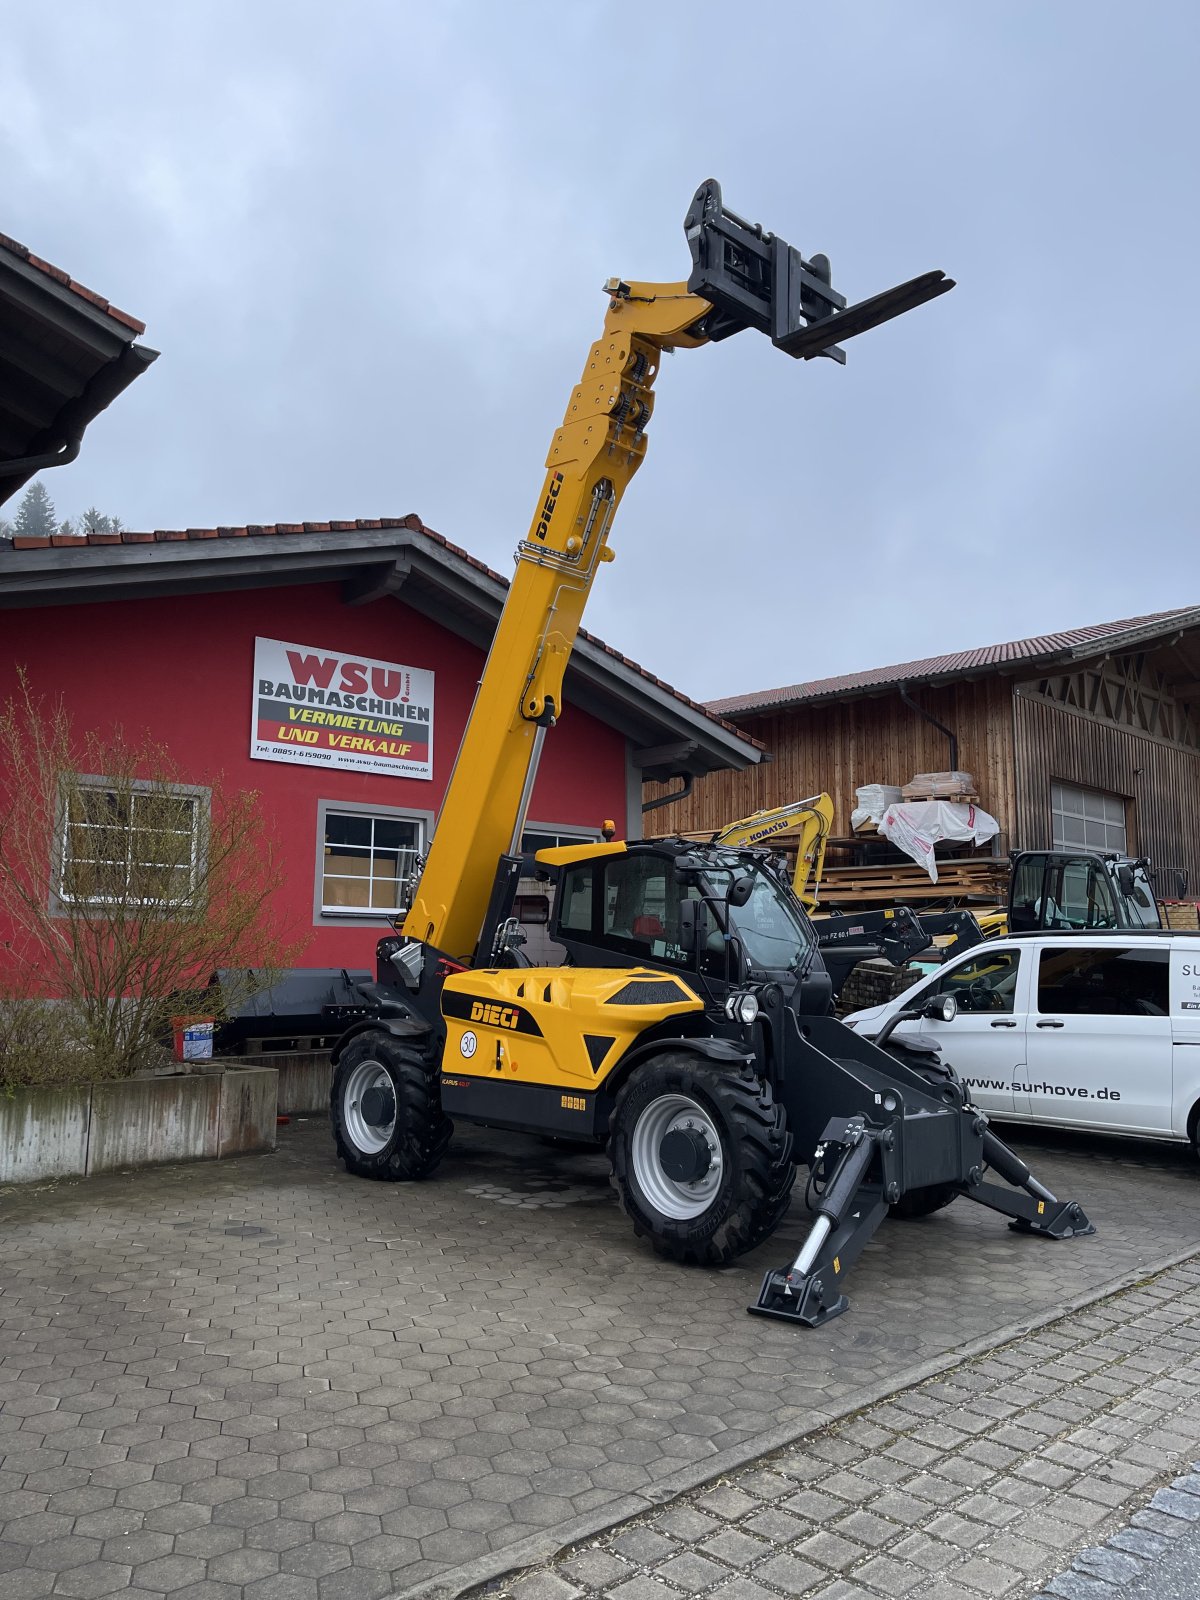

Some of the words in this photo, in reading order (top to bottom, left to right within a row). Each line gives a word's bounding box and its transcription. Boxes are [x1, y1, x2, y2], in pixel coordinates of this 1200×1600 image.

[536, 470, 564, 541] DIECI
[259, 679, 430, 722] BAUMASCHINEN
[288, 706, 404, 737] VERMIETUNG
[277, 726, 320, 744] UND
[328, 733, 412, 757] VERKAUF
[338, 757, 429, 773] www.wsu-baumaschinen.de
[749, 820, 789, 842] KOMATSU
[471, 1001, 520, 1029] DIECI
[461, 1036, 475, 1053] 30
[961, 1077, 1121, 1101] www.surhove.de
